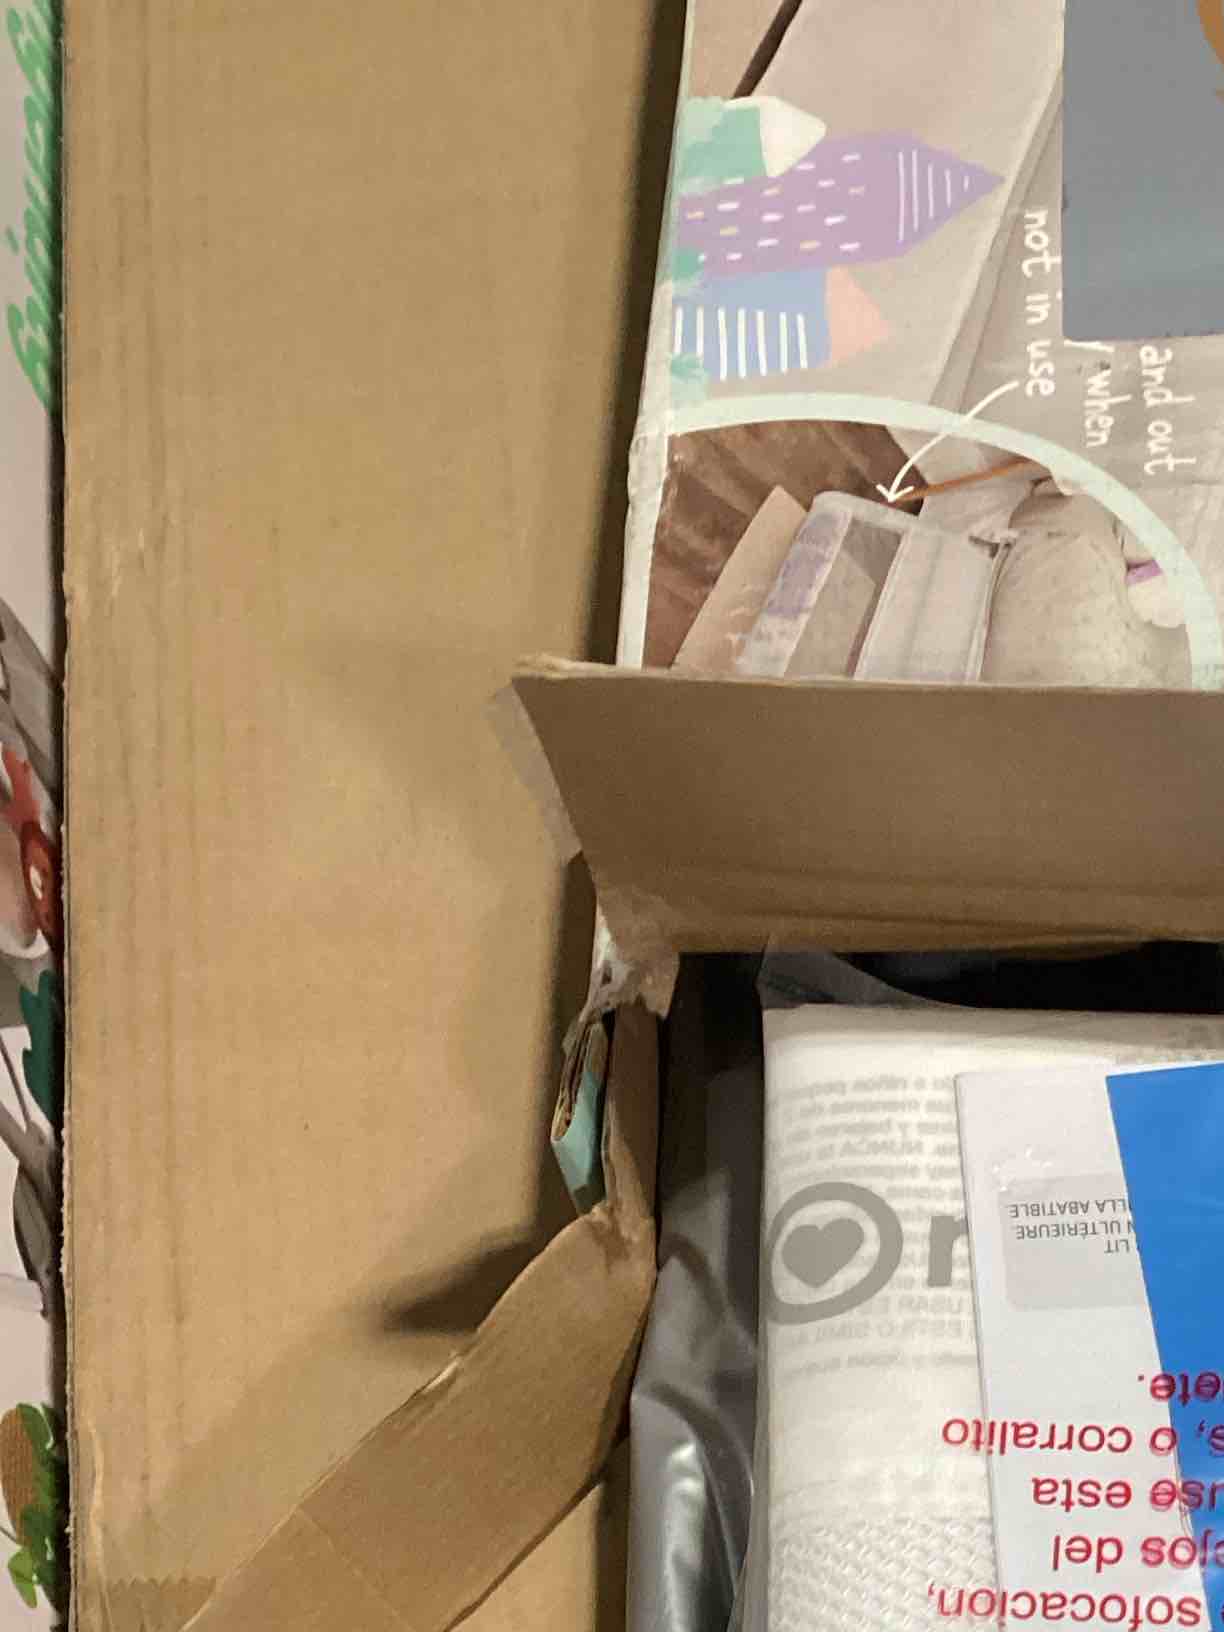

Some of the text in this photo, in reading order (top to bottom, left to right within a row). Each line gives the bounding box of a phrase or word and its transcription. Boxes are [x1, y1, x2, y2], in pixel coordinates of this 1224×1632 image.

[1022, 210, 1062, 397] not in use
[1084, 370, 1132, 448] when
[1140, 345, 1196, 474] and out
[1104, 1239, 1129, 1254] LIT
[942, 1419, 1132, 1455] corralito
[1149, 1427, 1178, 1458] o
[1032, 1478, 1132, 1512] esta
[1053, 1535, 1123, 1573] del
[927, 1582, 1202, 1632] sofocacion,
